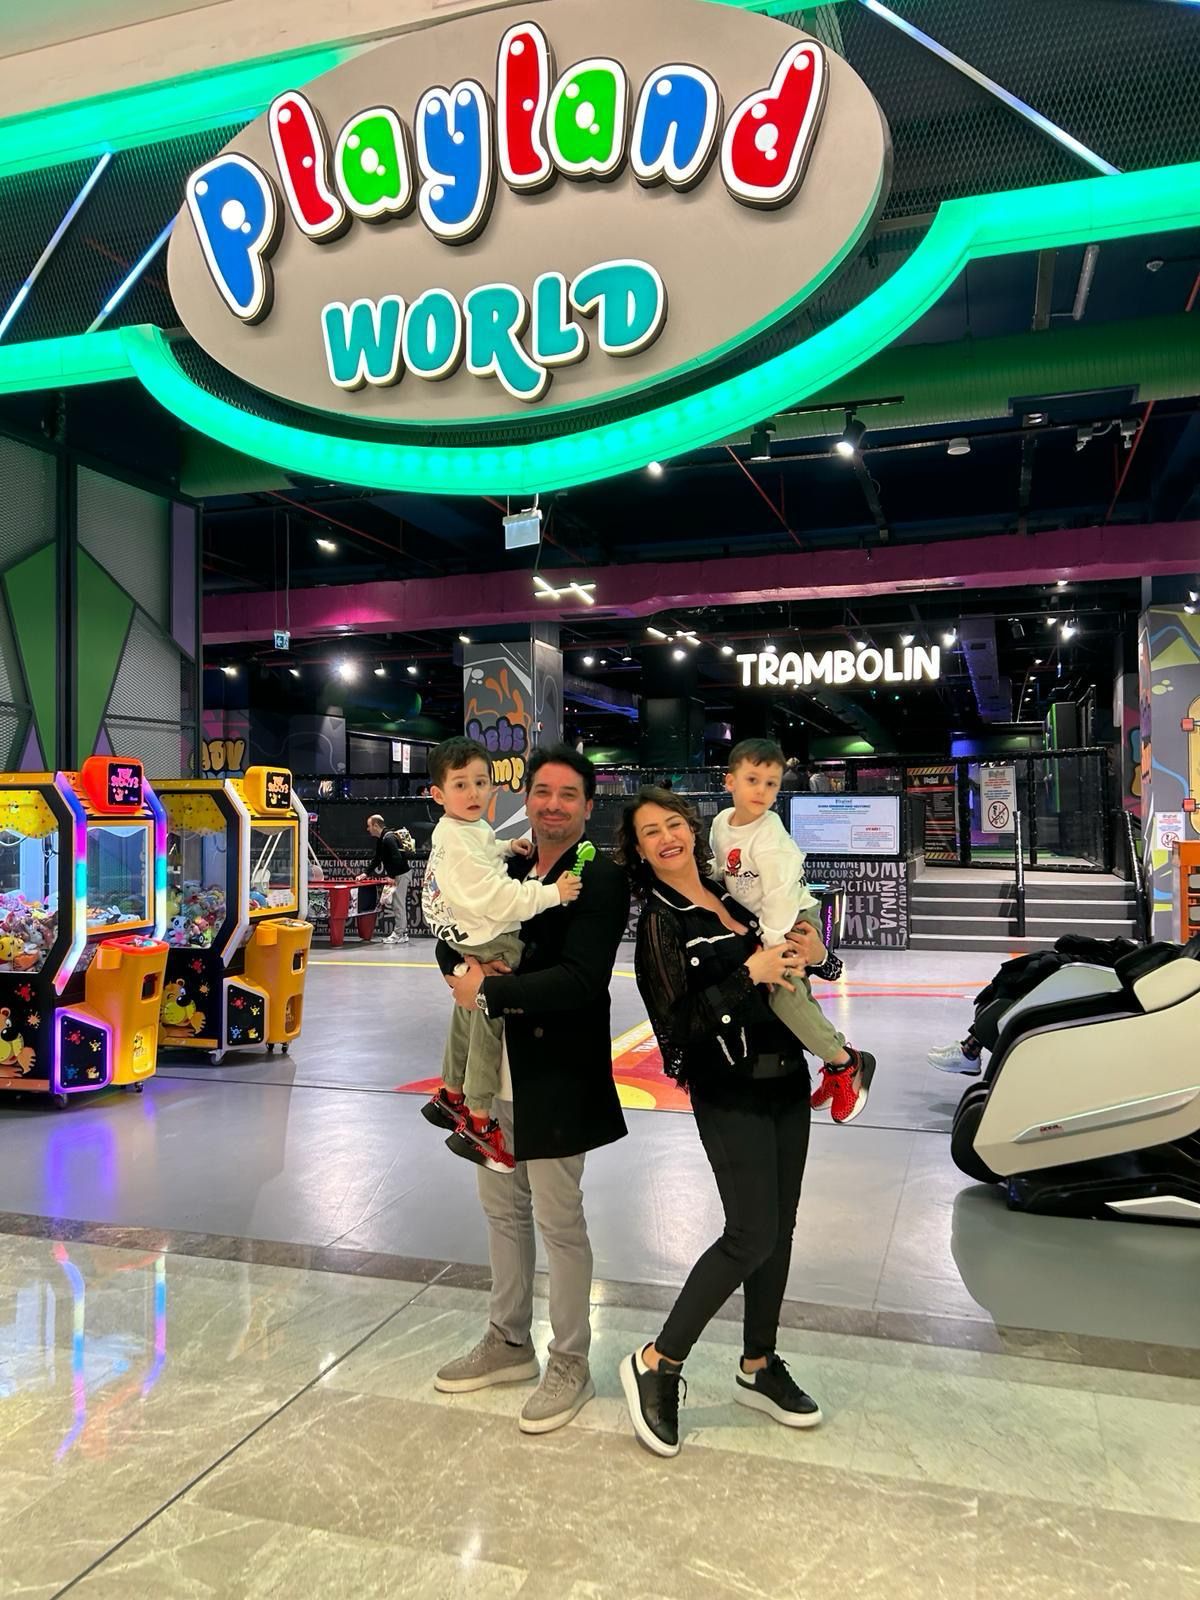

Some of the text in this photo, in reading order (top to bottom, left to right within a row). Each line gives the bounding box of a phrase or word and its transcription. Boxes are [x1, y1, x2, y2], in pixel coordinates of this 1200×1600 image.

[186, 22, 827, 322] Playland
[321, 259, 666, 402] WORLD
[845, 895, 879, 914] EET
[845, 914, 880, 939] MP
